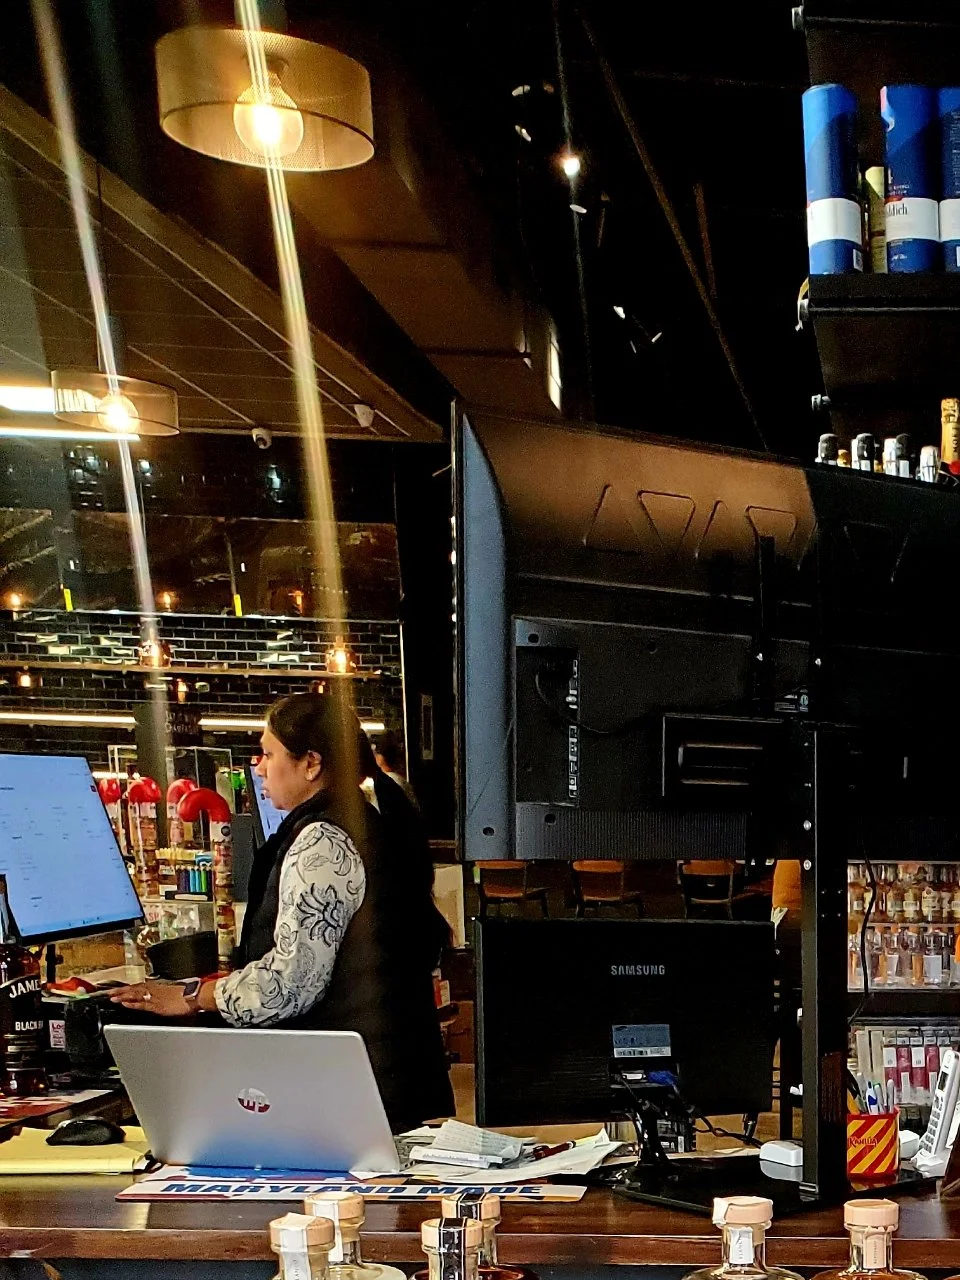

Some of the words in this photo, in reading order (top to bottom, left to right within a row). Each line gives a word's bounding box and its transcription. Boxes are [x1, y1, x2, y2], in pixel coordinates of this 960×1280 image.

[610, 964, 666, 976] SAMSUNG
[160, 1183, 408, 1194] MARYLAND
[417, 1185, 543, 1195] MADE
